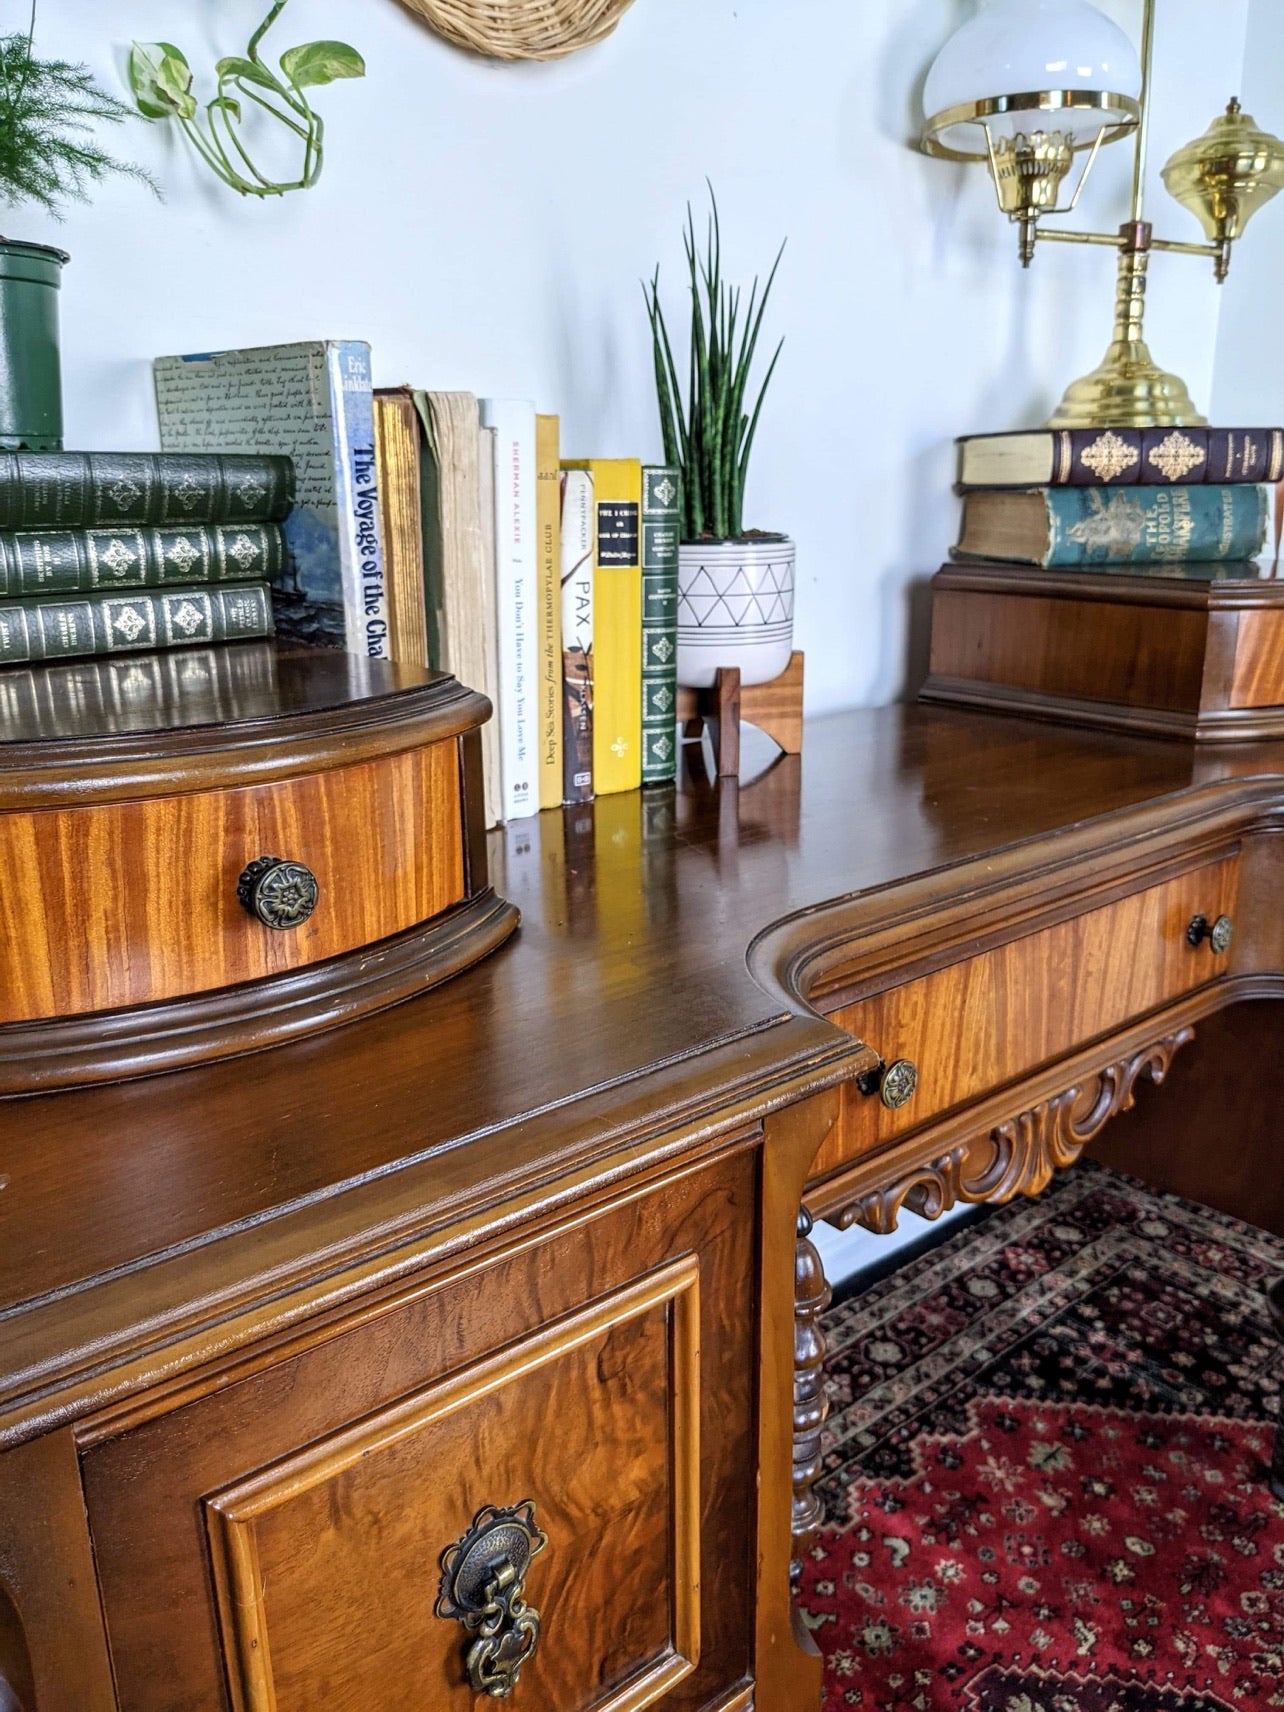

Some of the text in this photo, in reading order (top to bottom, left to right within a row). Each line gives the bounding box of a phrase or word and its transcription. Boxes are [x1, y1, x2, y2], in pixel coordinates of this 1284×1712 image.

[348, 356, 367, 373] Eric
[513, 503, 521, 544] ALEXIE
[579, 484, 588, 549] PENNYPACKER
[1145, 504, 1158, 547] THE
[45, 565, 53, 577] BY
[354, 444, 388, 660] The Voyage of the Cha
[575, 581, 591, 627] PAX
[2, 622, 11, 649] TWIST
[59, 612, 69, 648] CHARLES
[67, 613, 78, 646] DICKENS
[544, 524, 558, 765] Deep Sea Stories from the THERMOPYLAE CLUB
[514, 578, 527, 761] You Don't Have to Say You Love Me
